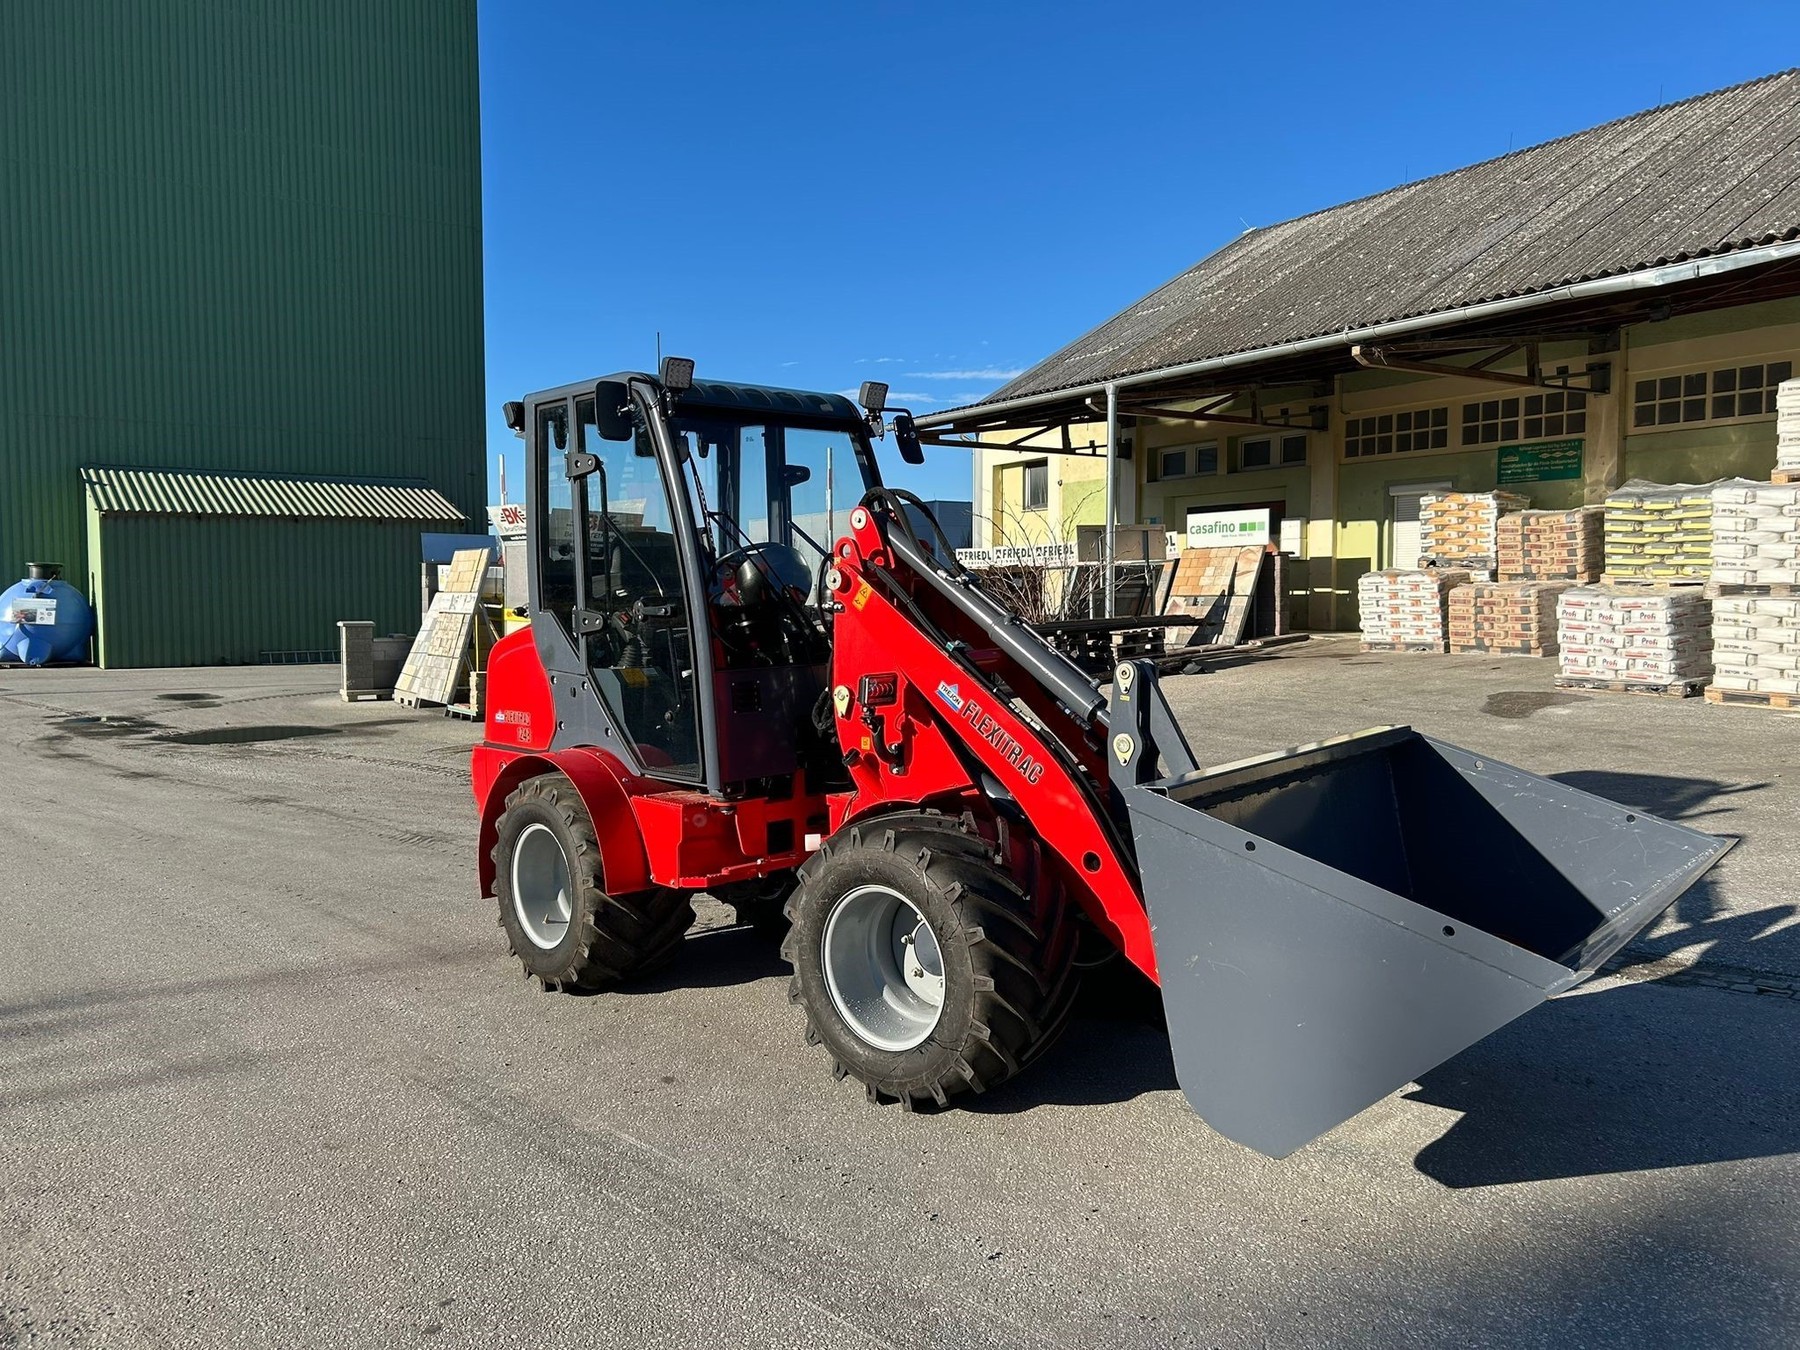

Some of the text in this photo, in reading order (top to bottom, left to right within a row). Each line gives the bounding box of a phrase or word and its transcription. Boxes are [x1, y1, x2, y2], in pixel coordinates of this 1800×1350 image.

[501, 506, 525, 524] BK
[1190, 521, 1236, 535] casafino
[964, 550, 992, 561] FRIEDL
[1002, 548, 1032, 559] FRIEDL
[1043, 544, 1075, 557] FRIEDL
[1562, 610, 1577, 618] Profi
[1598, 613, 1614, 621] Profi
[1600, 636, 1614, 644] Profi
[1602, 658, 1618, 667] Profi
[1642, 661, 1659, 670] Profi
[940, 684, 962, 706] TREJON
[961, 699, 1044, 785] FLEXITRAC
